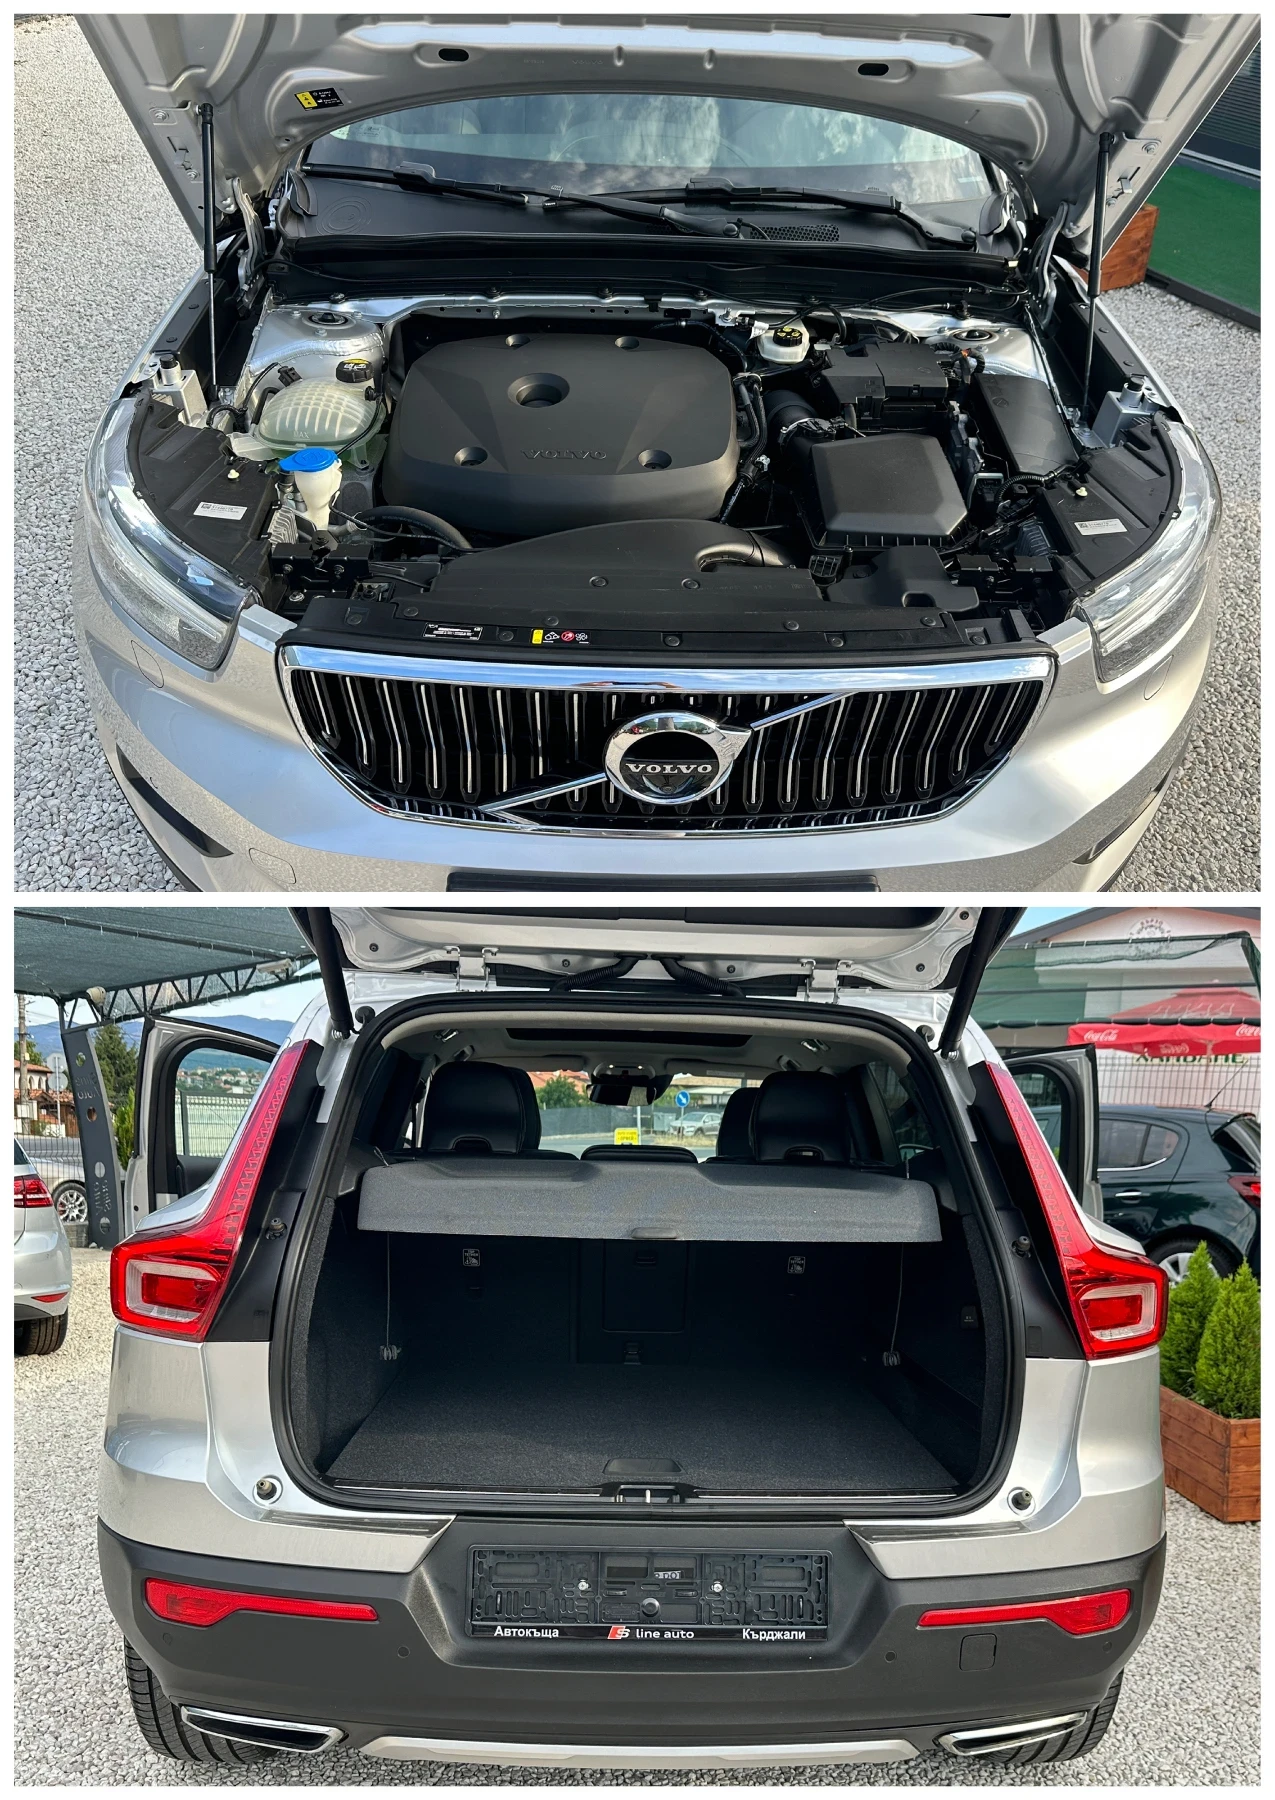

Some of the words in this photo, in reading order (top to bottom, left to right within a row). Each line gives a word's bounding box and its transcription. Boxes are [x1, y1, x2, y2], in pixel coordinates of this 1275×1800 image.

[520, 449, 607, 460] VOLVO
[625, 763, 712, 774] VOLVO
[1083, 1029, 1119, 1041] Coca-Cola
[493, 1625, 559, 1638] Автокъща
[635, 1628, 660, 1639] line
[663, 1629, 695, 1639] auto
[742, 1628, 806, 1641] Кърджали
